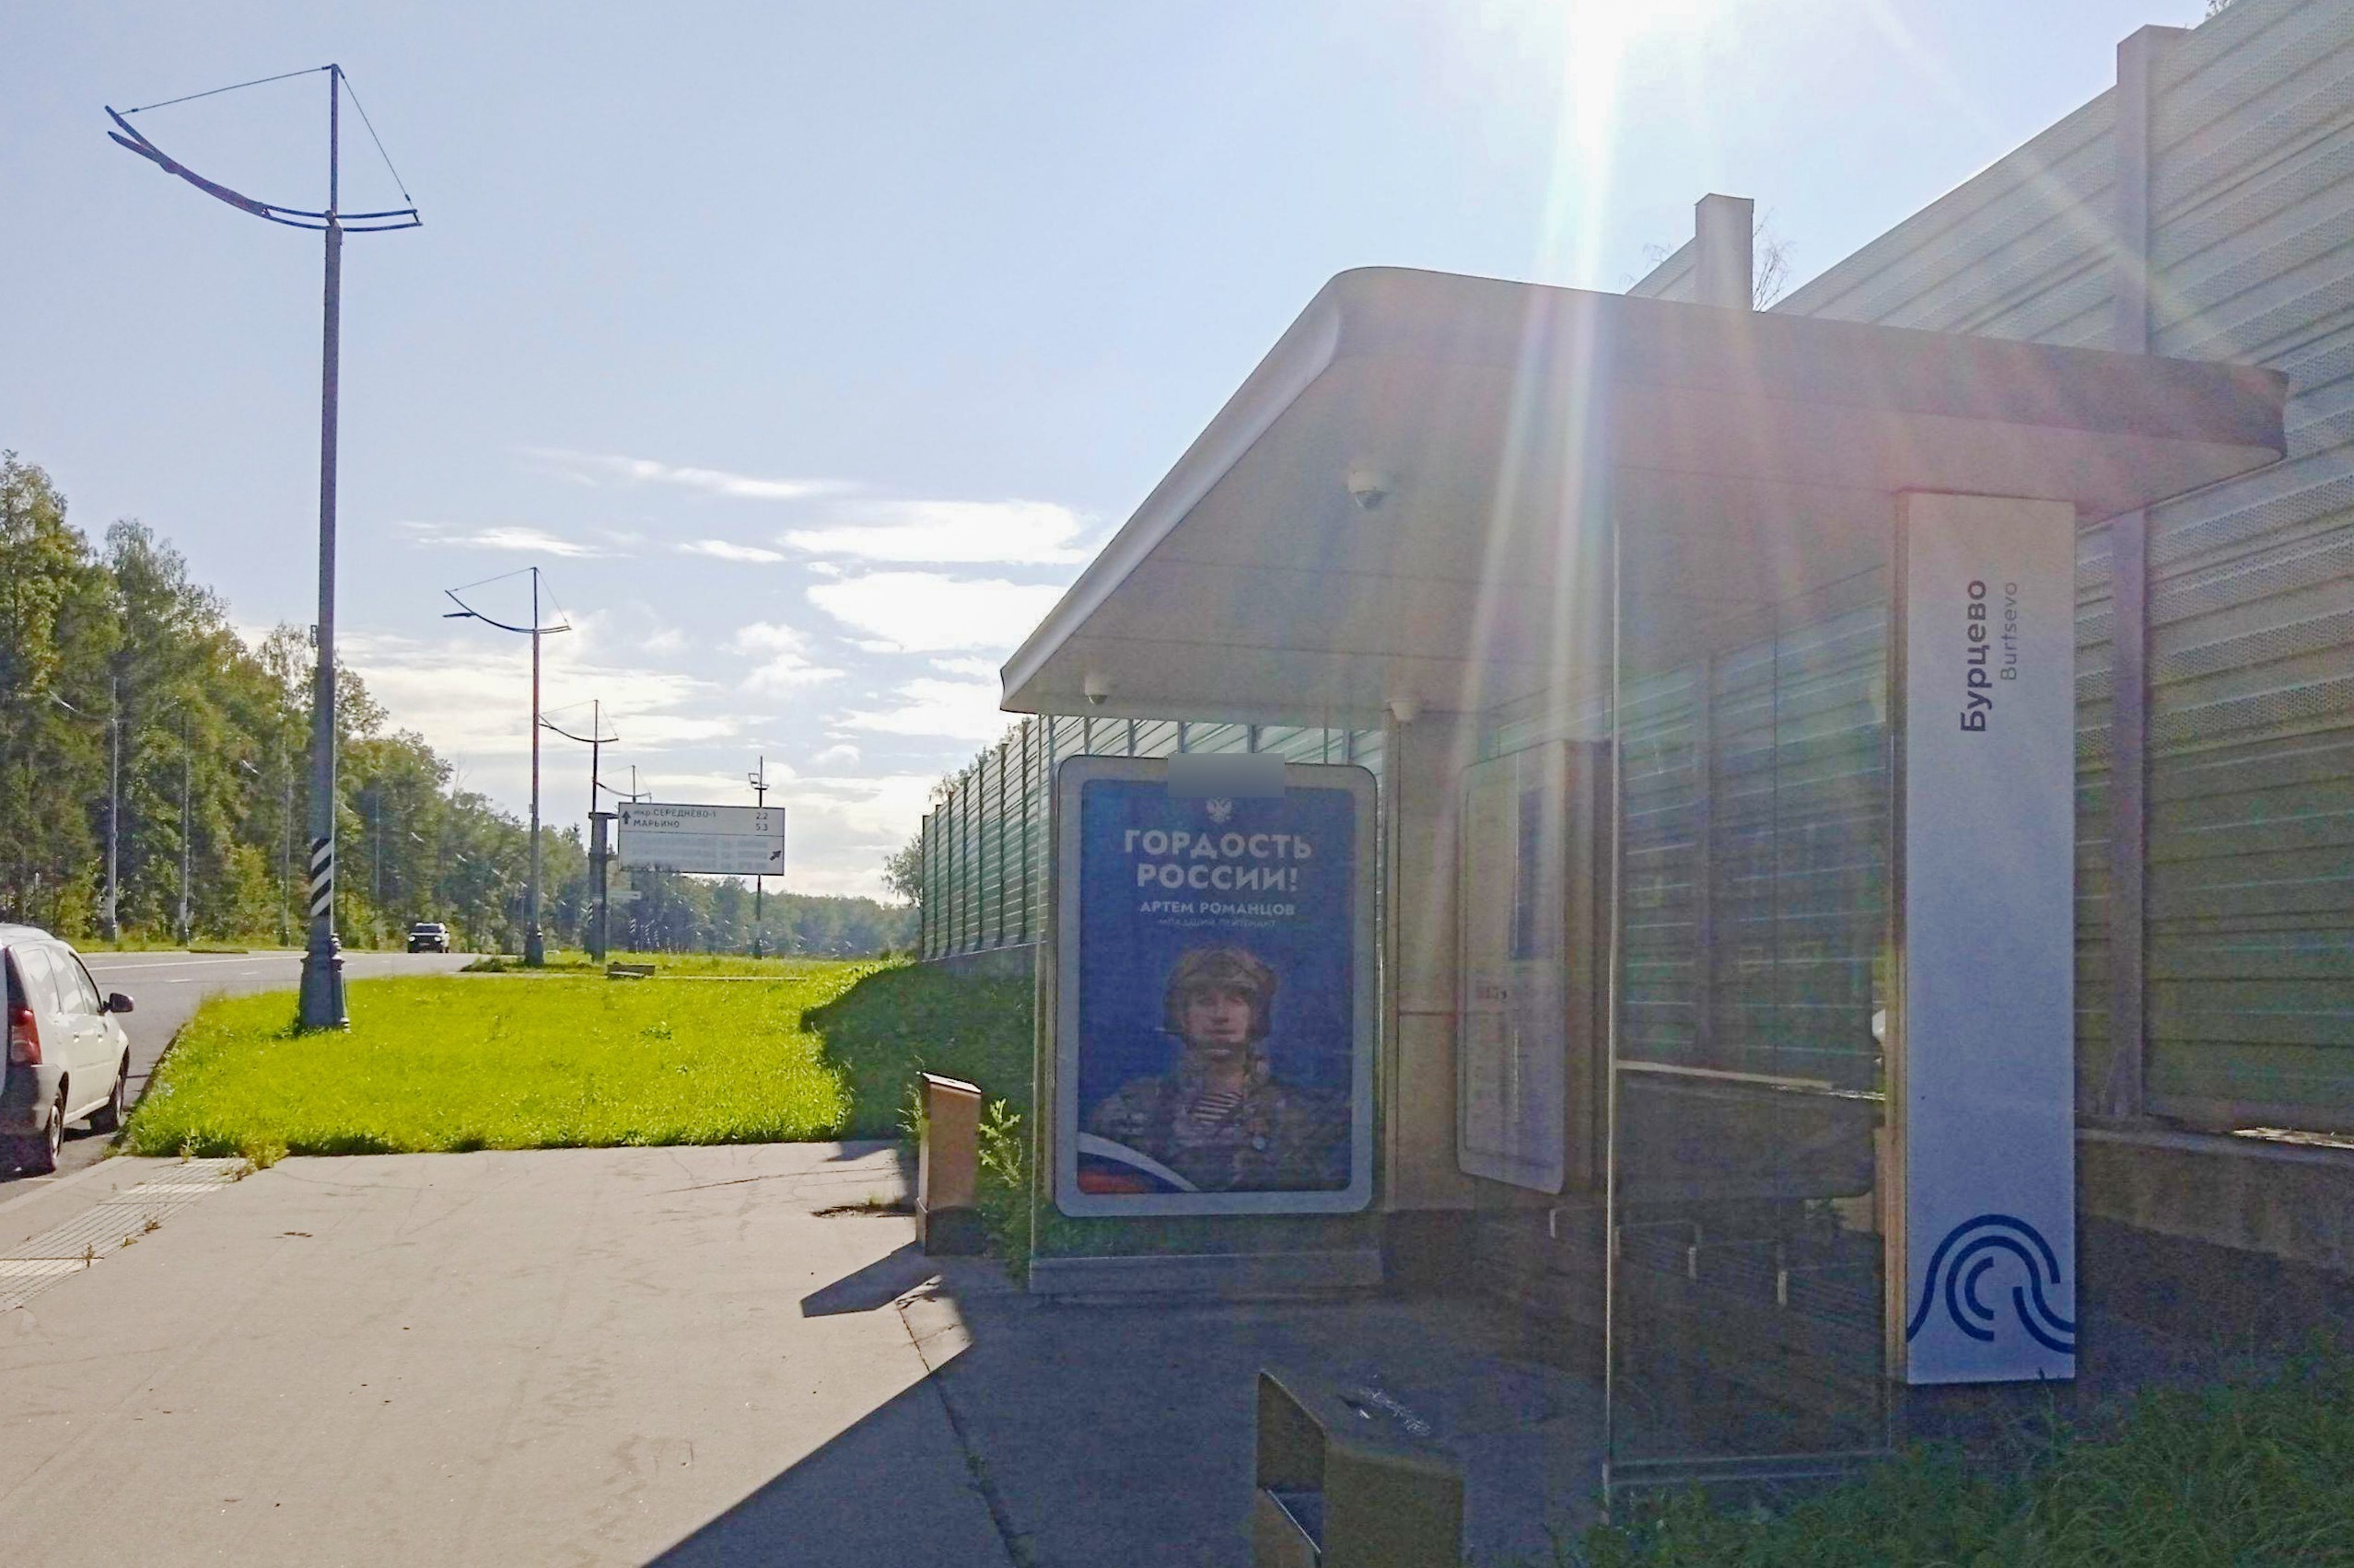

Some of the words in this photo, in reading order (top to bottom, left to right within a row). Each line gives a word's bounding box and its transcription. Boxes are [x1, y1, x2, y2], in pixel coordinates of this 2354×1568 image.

[2000, 582, 2018, 679] Burtsevo
[1960, 580, 1992, 732] Бурцево
[634, 819, 680, 828] МАРЬИНО
[1124, 830, 1311, 858] ГОРДОСТЬ
[1136, 864, 1299, 891] РОССИИ!
[1140, 900, 1194, 913] АРТЕМ
[1200, 902, 1295, 915] РОМАНЦОВ
